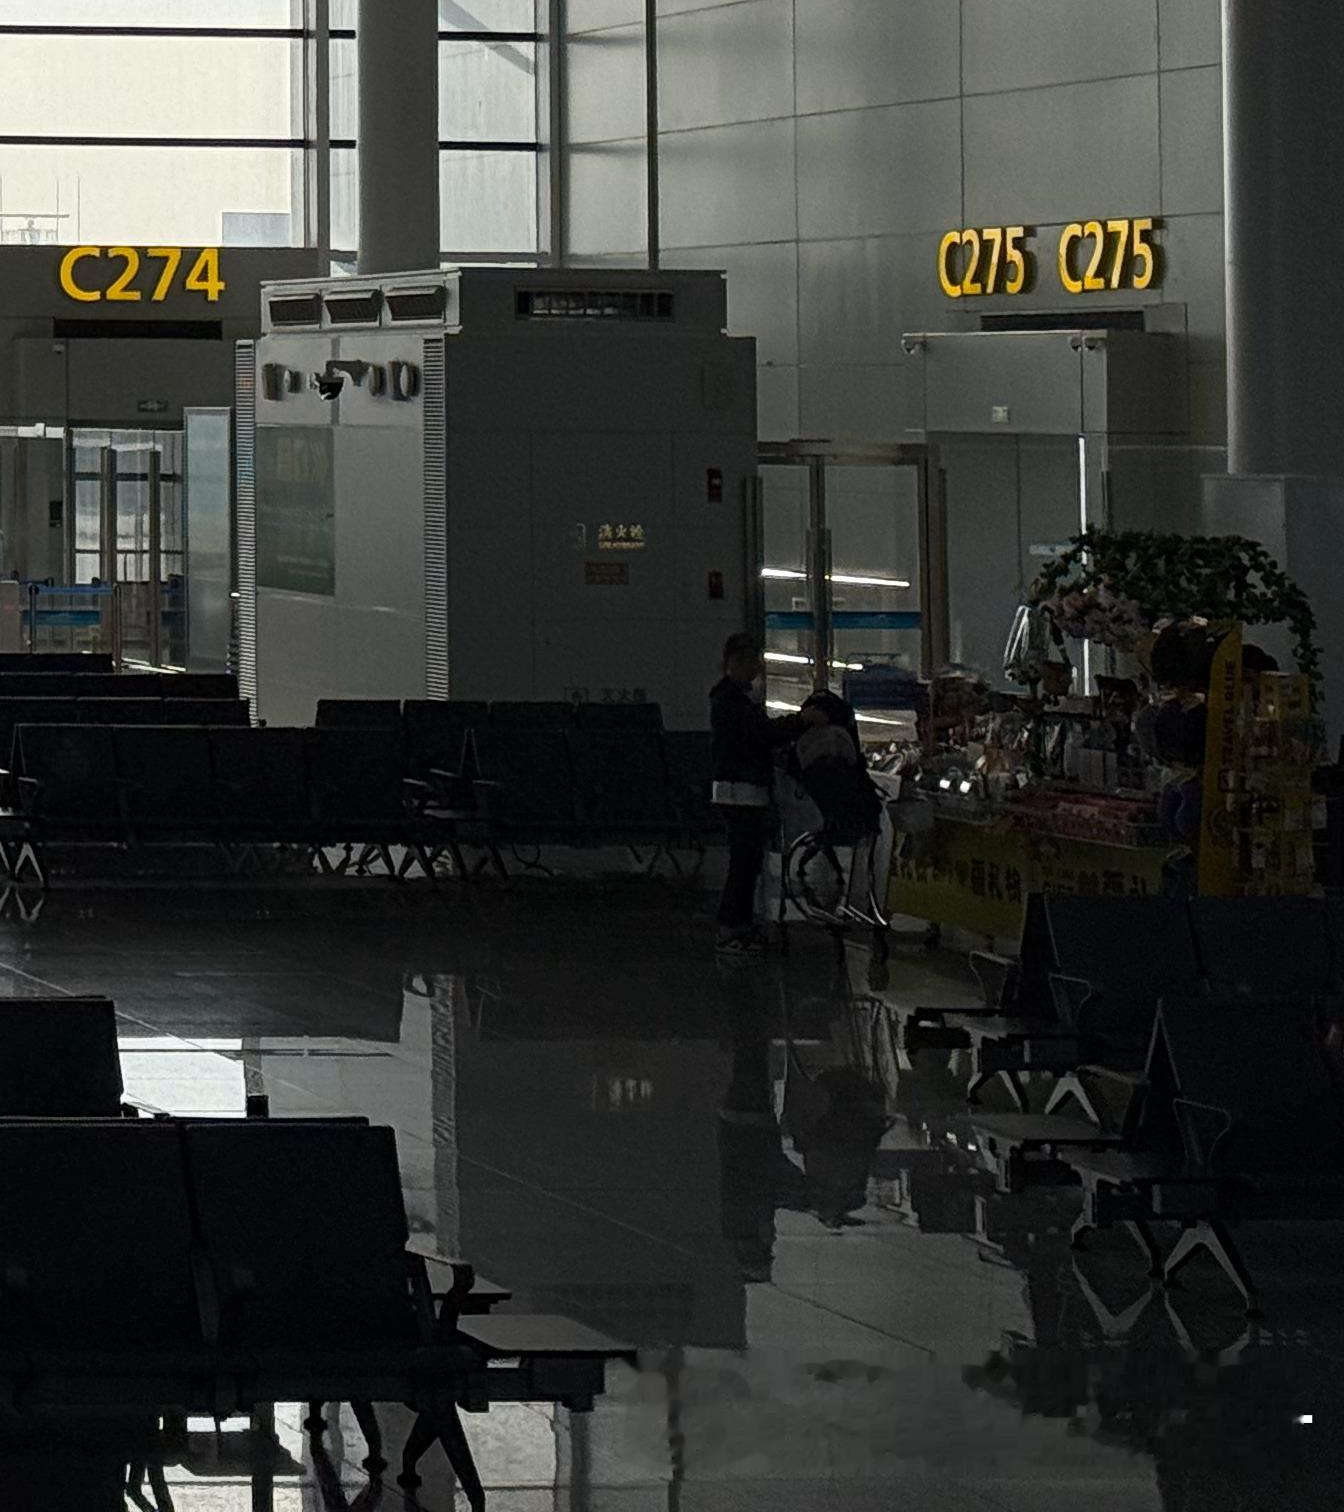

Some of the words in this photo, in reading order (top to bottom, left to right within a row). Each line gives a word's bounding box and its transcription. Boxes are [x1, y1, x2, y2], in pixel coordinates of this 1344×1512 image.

[58, 244, 226, 303] C274
[936, 226, 1027, 297] C275
[1057, 217, 1155, 295] C275
[1223, 658, 1235, 701] BLUE
[1221, 707, 1234, 766] TRAVEL
